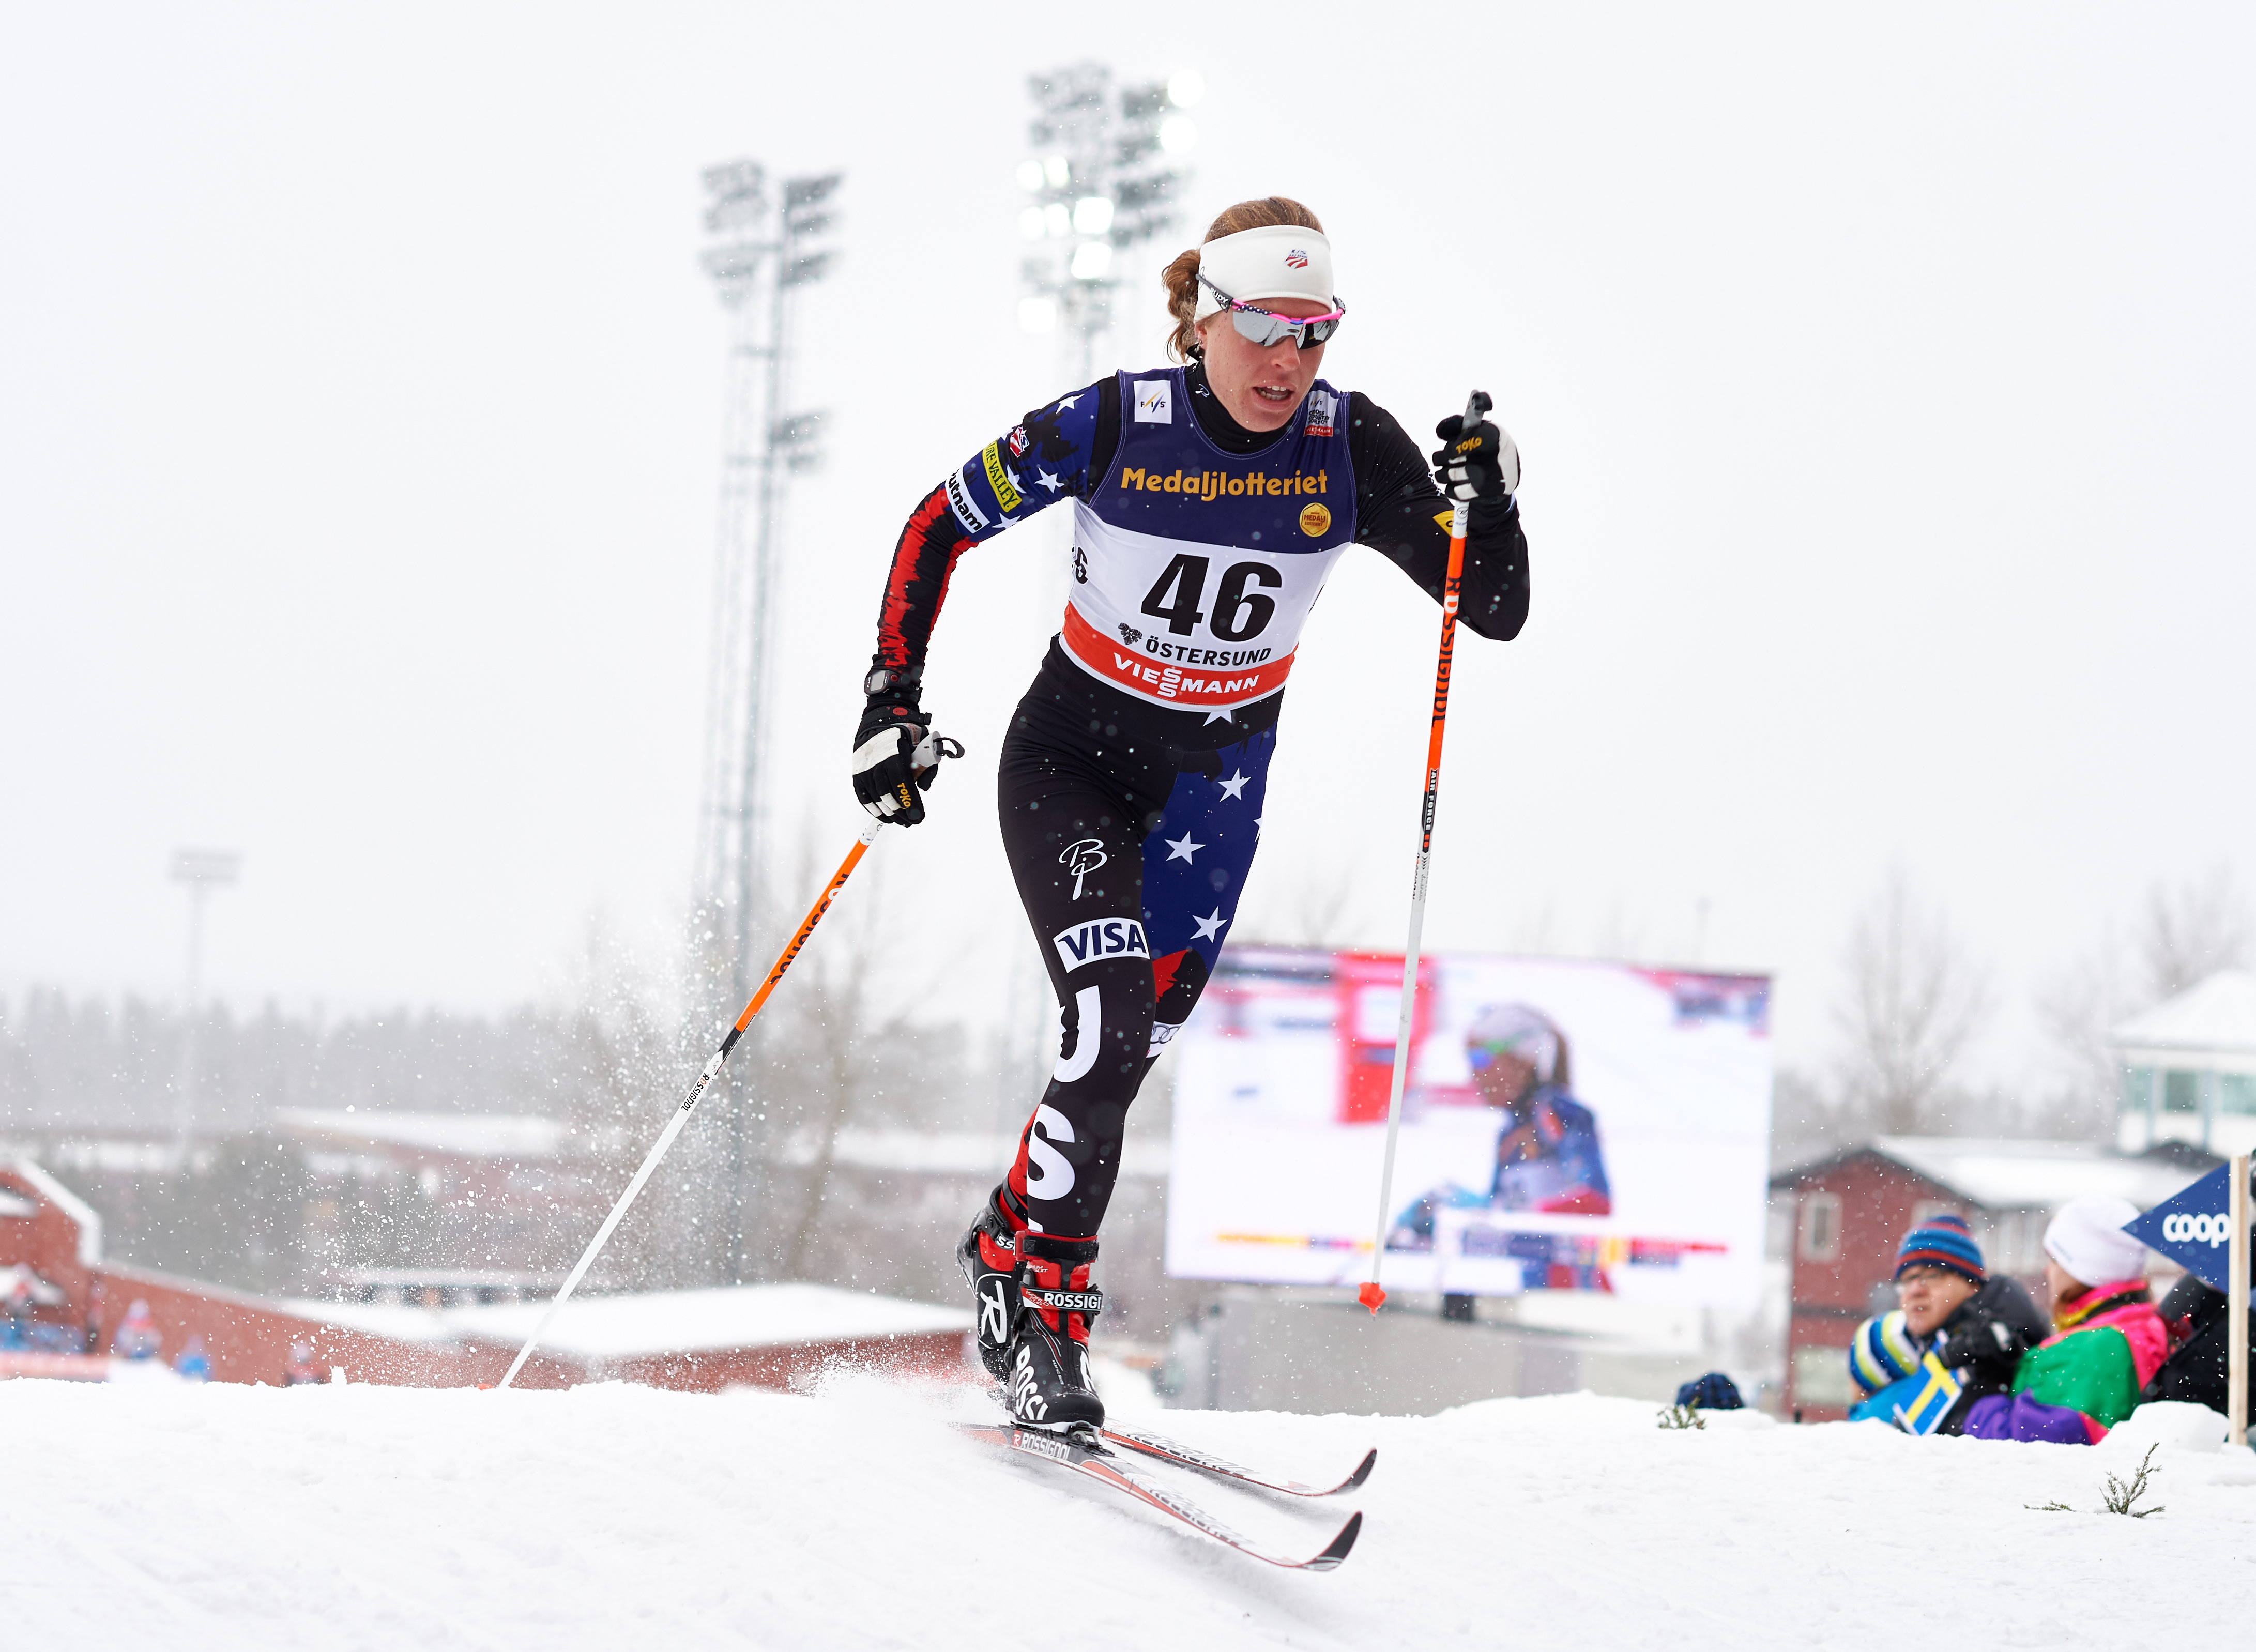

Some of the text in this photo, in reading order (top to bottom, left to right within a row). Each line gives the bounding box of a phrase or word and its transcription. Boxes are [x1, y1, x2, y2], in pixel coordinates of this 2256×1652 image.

[1210, 287, 1229, 303] RUDY
[1455, 436, 1483, 454] TOKO
[948, 472, 983, 531] utnam
[1120, 467, 1328, 502] Medaljlotteriet
[1072, 546, 1088, 584] 6
[1140, 553, 1282, 642] 46
[1145, 635, 1272, 667] ÖSTERSUND
[1114, 652, 1260, 698] VIESSMANN
[897, 782, 912, 808] TOKO
[1057, 922, 1148, 961] VISA
[681, 1073, 710, 1111] ROSSIGNOL
[2162, 1213, 2230, 1249] coop
[1025, 1290, 1050, 1307] WORLD
